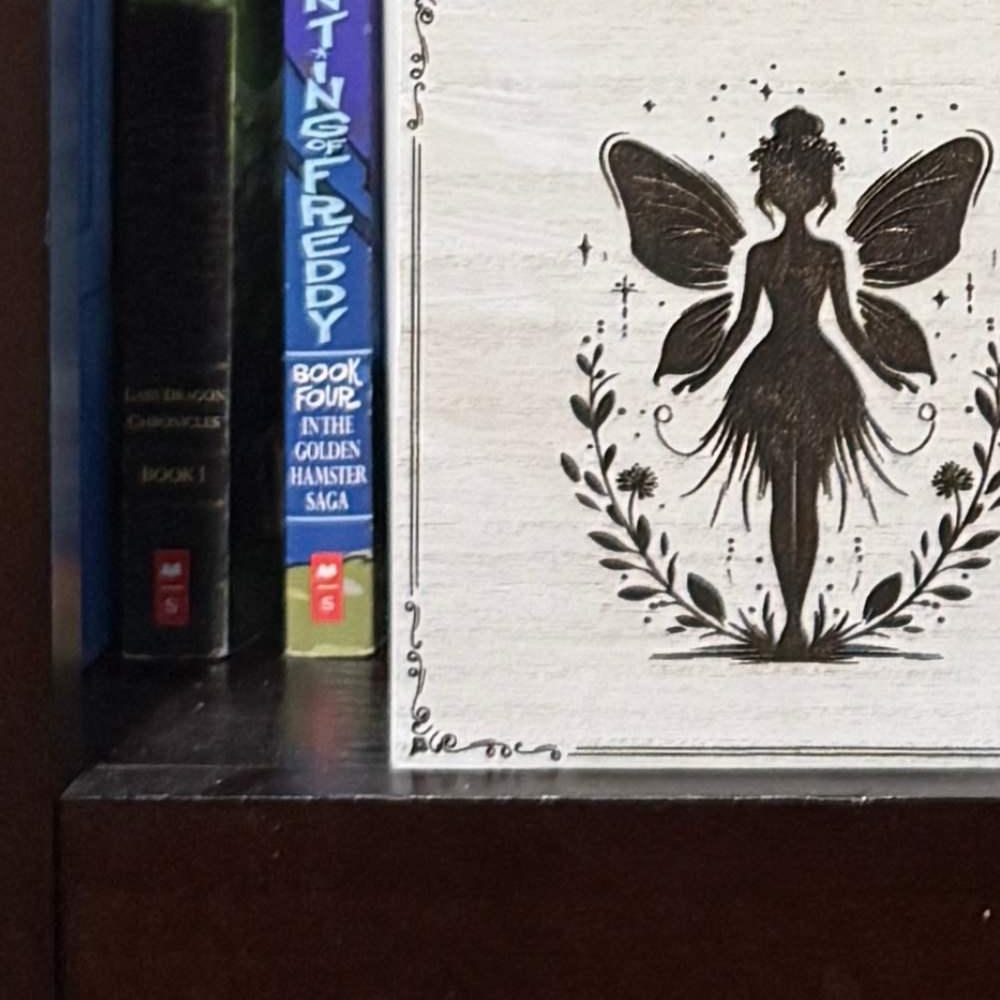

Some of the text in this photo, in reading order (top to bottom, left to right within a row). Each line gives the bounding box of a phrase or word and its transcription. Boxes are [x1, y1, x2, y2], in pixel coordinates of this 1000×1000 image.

[304, 137, 348, 155] OF
[300, 154, 354, 344] FREDDY
[292, 357, 364, 387] BOOK
[294, 384, 362, 411] FOUR
[301, 415, 355, 435] IN THE
[294, 440, 362, 461] GOLDEN
[290, 465, 368, 487] HAMSTER
[304, 491, 350, 512] SAGA
